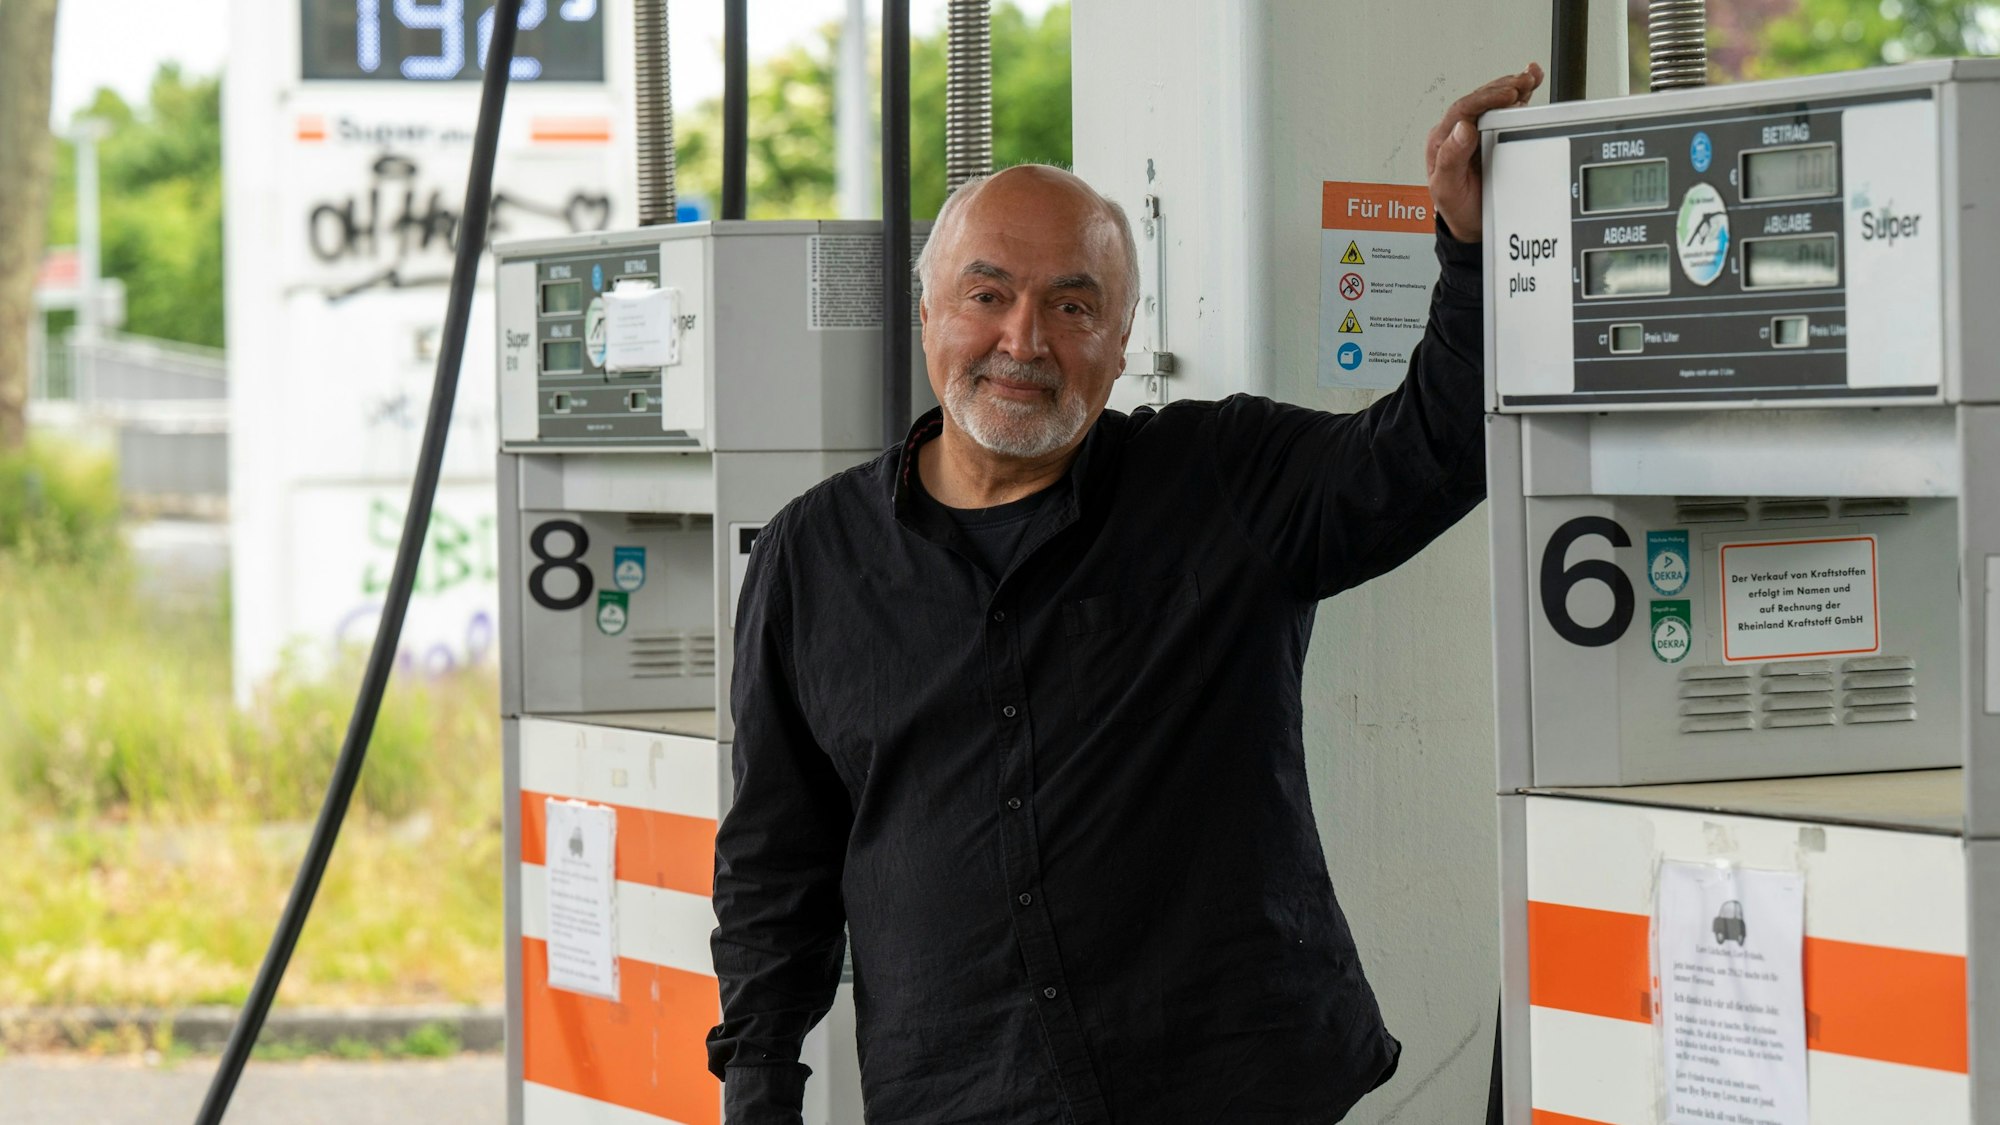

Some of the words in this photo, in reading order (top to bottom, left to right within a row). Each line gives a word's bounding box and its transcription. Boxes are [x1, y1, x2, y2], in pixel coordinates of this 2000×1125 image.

[357, 0, 597, 80] 192
[1762, 123, 1809, 144] BETRAG
[1602, 139, 1645, 159] BETRAG
[1347, 198, 1382, 218] Für
[1388, 200, 1427, 220] Ihre
[1763, 213, 1812, 234] ABGABE
[1861, 211, 1921, 247] Super
[1603, 225, 1647, 244] ABGABE
[1509, 233, 1558, 266] Super
[1509, 272, 1536, 298] plus
[679, 314, 697, 337] per
[528, 519, 594, 612] 8
[1654, 571, 1683, 581] DEKRA
[1731, 574, 1748, 583] Der
[1751, 571, 1788, 582] Verkauf
[1811, 567, 1866, 578] Kraftstoffen
[1540, 515, 1636, 648] 6
[1748, 588, 1780, 599] erfolgt
[1783, 587, 1794, 596] im
[1797, 586, 1830, 595] Namen
[1833, 584, 1851, 593] und
[1760, 605, 1775, 614] auf
[1778, 603, 1822, 613] Rechnung
[1825, 601, 1841, 610] der
[1738, 620, 1784, 631] Rheinland
[1787, 617, 1832, 628] Kraftstoff
[1834, 615, 1863, 625] GmbH
[1657, 640, 1685, 649] DEKRA
